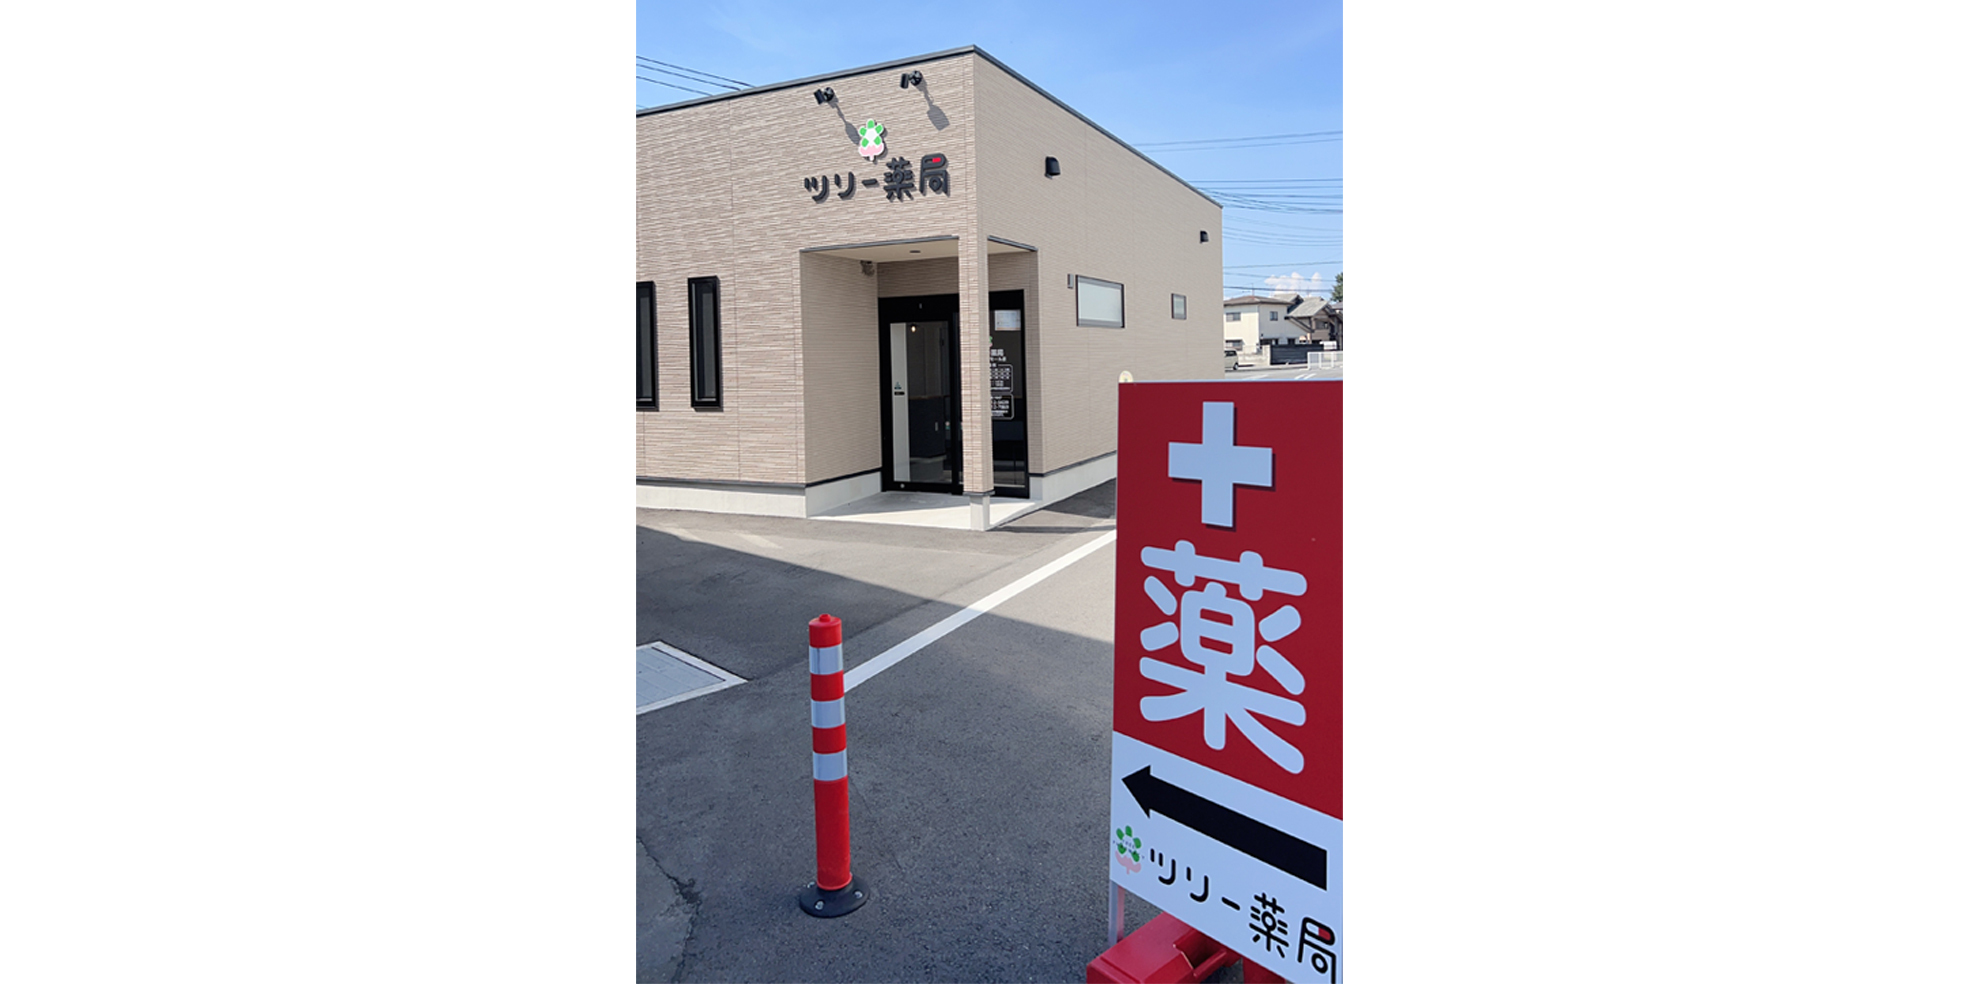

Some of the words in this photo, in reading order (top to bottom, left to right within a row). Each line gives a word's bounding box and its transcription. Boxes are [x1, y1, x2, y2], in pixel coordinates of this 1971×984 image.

[804, 153, 949, 202] ツリー薬局
[1139, 539, 1307, 774] 薬
[1150, 848, 1335, 984] ツリー薬局
